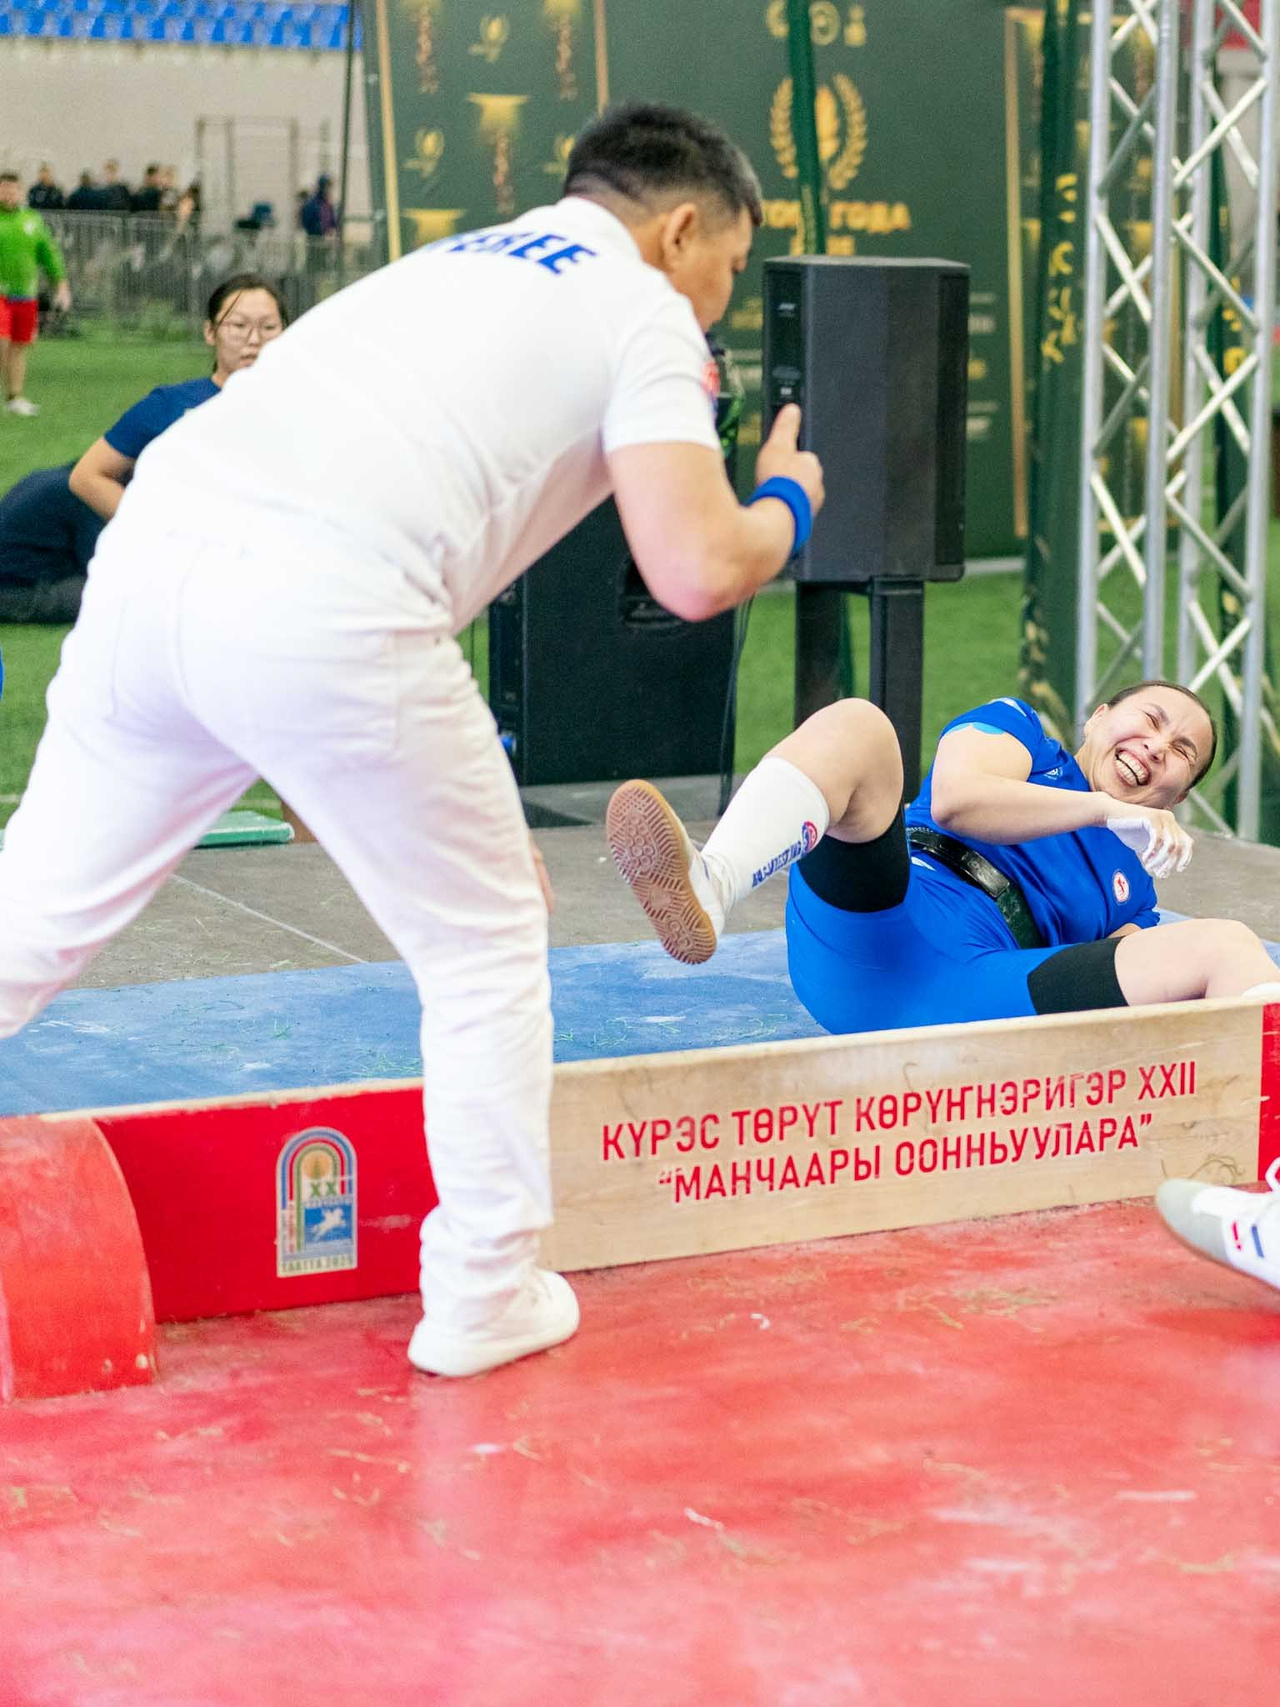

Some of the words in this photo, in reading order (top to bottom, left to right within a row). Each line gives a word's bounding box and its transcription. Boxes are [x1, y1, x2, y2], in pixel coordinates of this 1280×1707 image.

[602, 1113, 720, 1161] КҮРЭС
[730, 1099, 843, 1146] ТӨРҮТ
[1138, 1061, 1196, 1100] XXII
